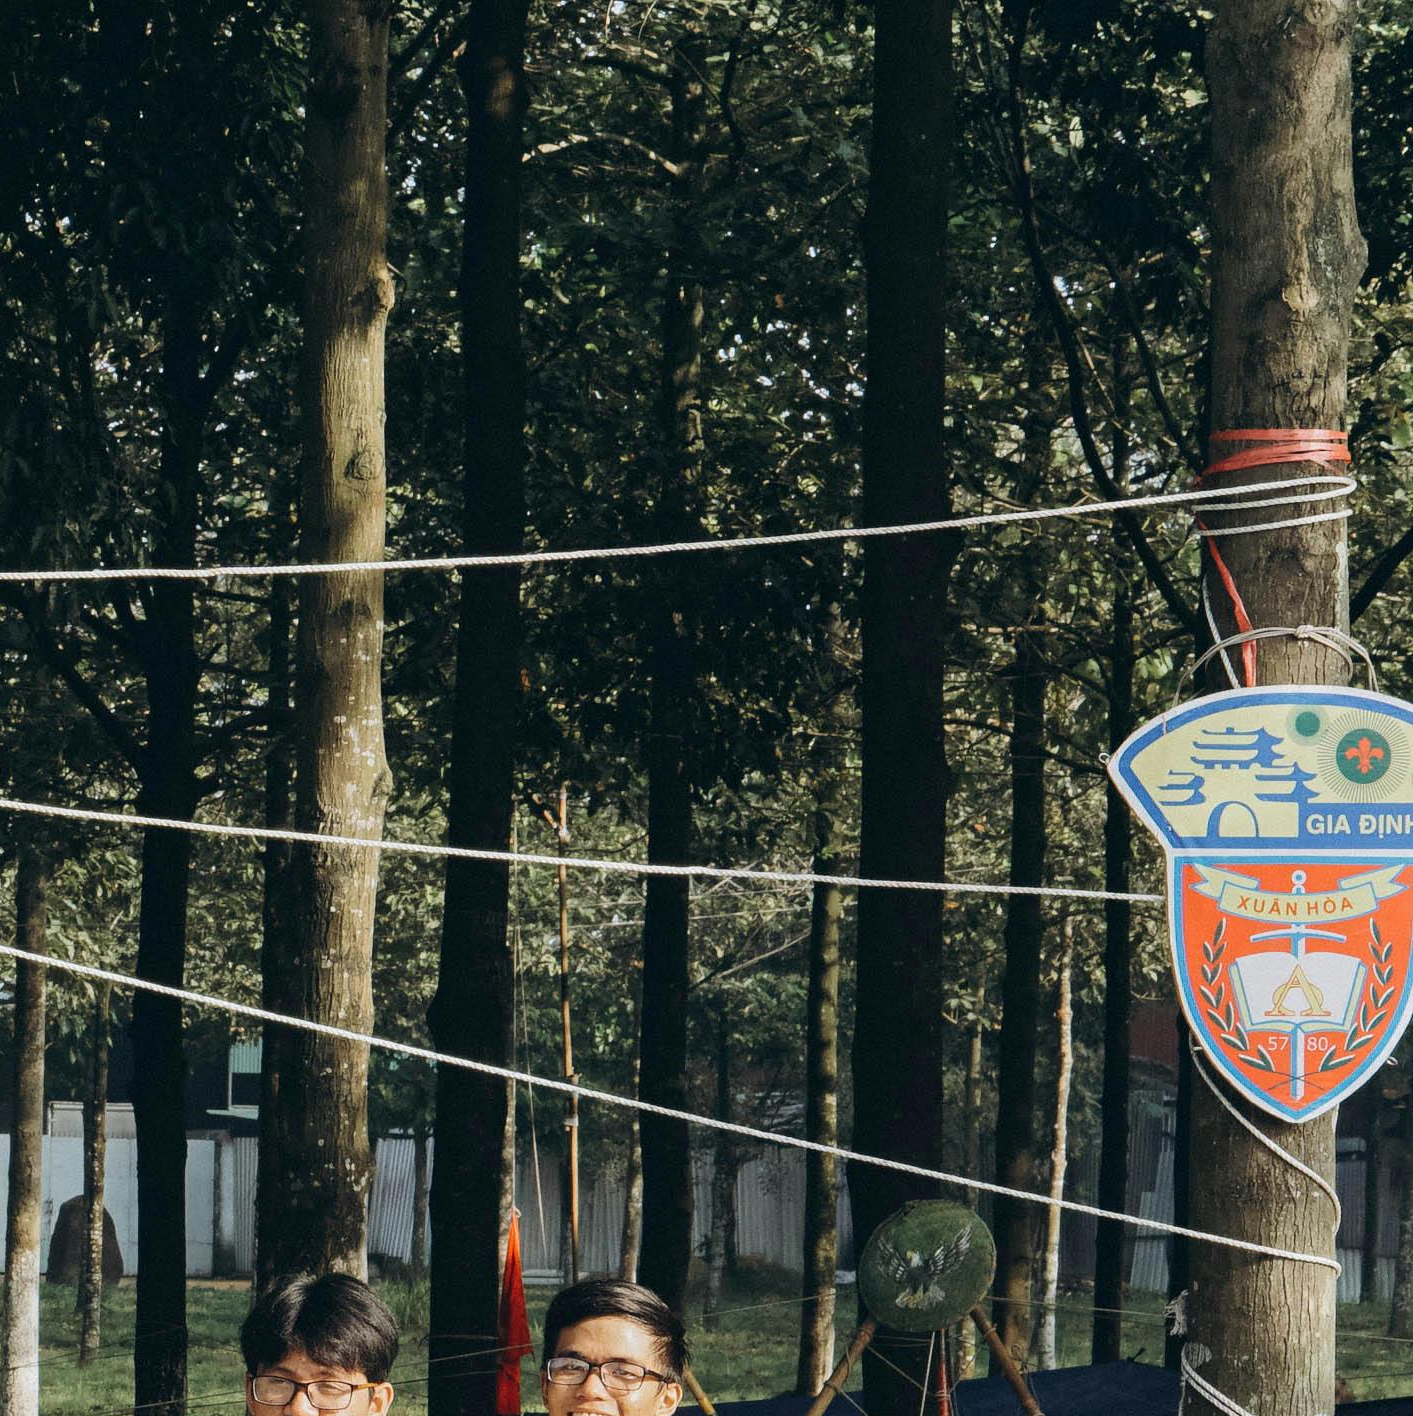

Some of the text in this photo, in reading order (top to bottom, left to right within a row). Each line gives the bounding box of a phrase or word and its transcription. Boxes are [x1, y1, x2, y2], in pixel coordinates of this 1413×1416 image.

[1306, 813, 1351, 834] GIA
[1236, 895, 1354, 916] XUÂN HÒA
[1268, 1036, 1328, 1051] 57 80
